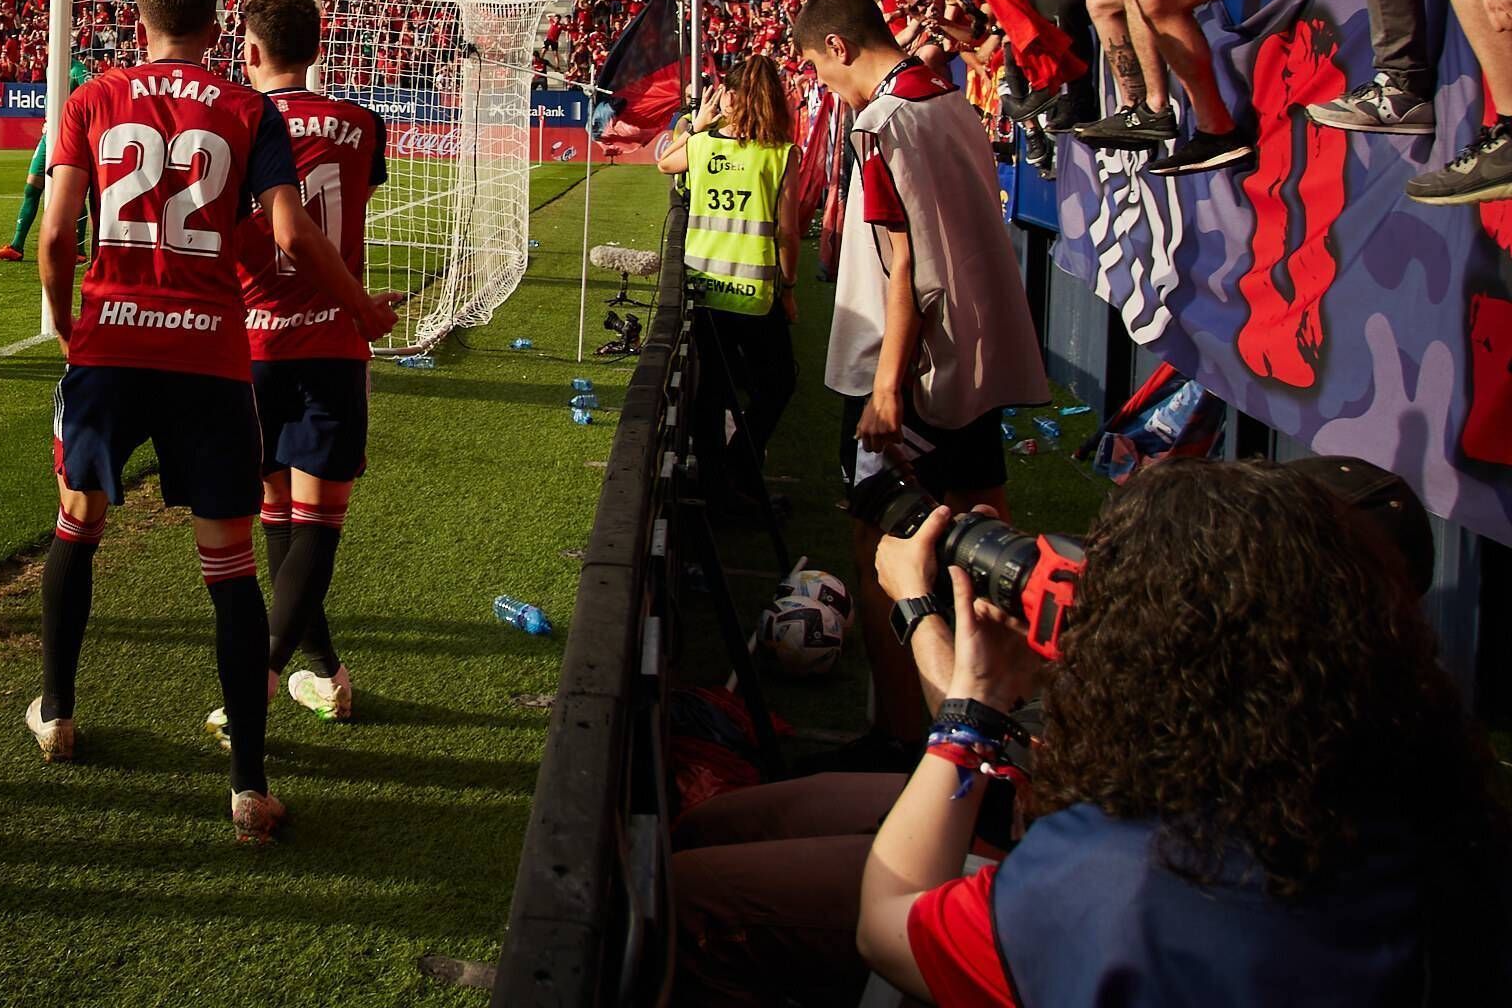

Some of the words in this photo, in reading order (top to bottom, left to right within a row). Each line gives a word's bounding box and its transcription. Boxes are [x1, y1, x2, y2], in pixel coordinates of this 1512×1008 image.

[130, 75, 221, 107] AIMAR
[288, 116, 363, 150] BARJA
[99, 123, 232, 258] 22
[707, 188, 753, 212] 337
[98, 301, 223, 332] HRmotor
